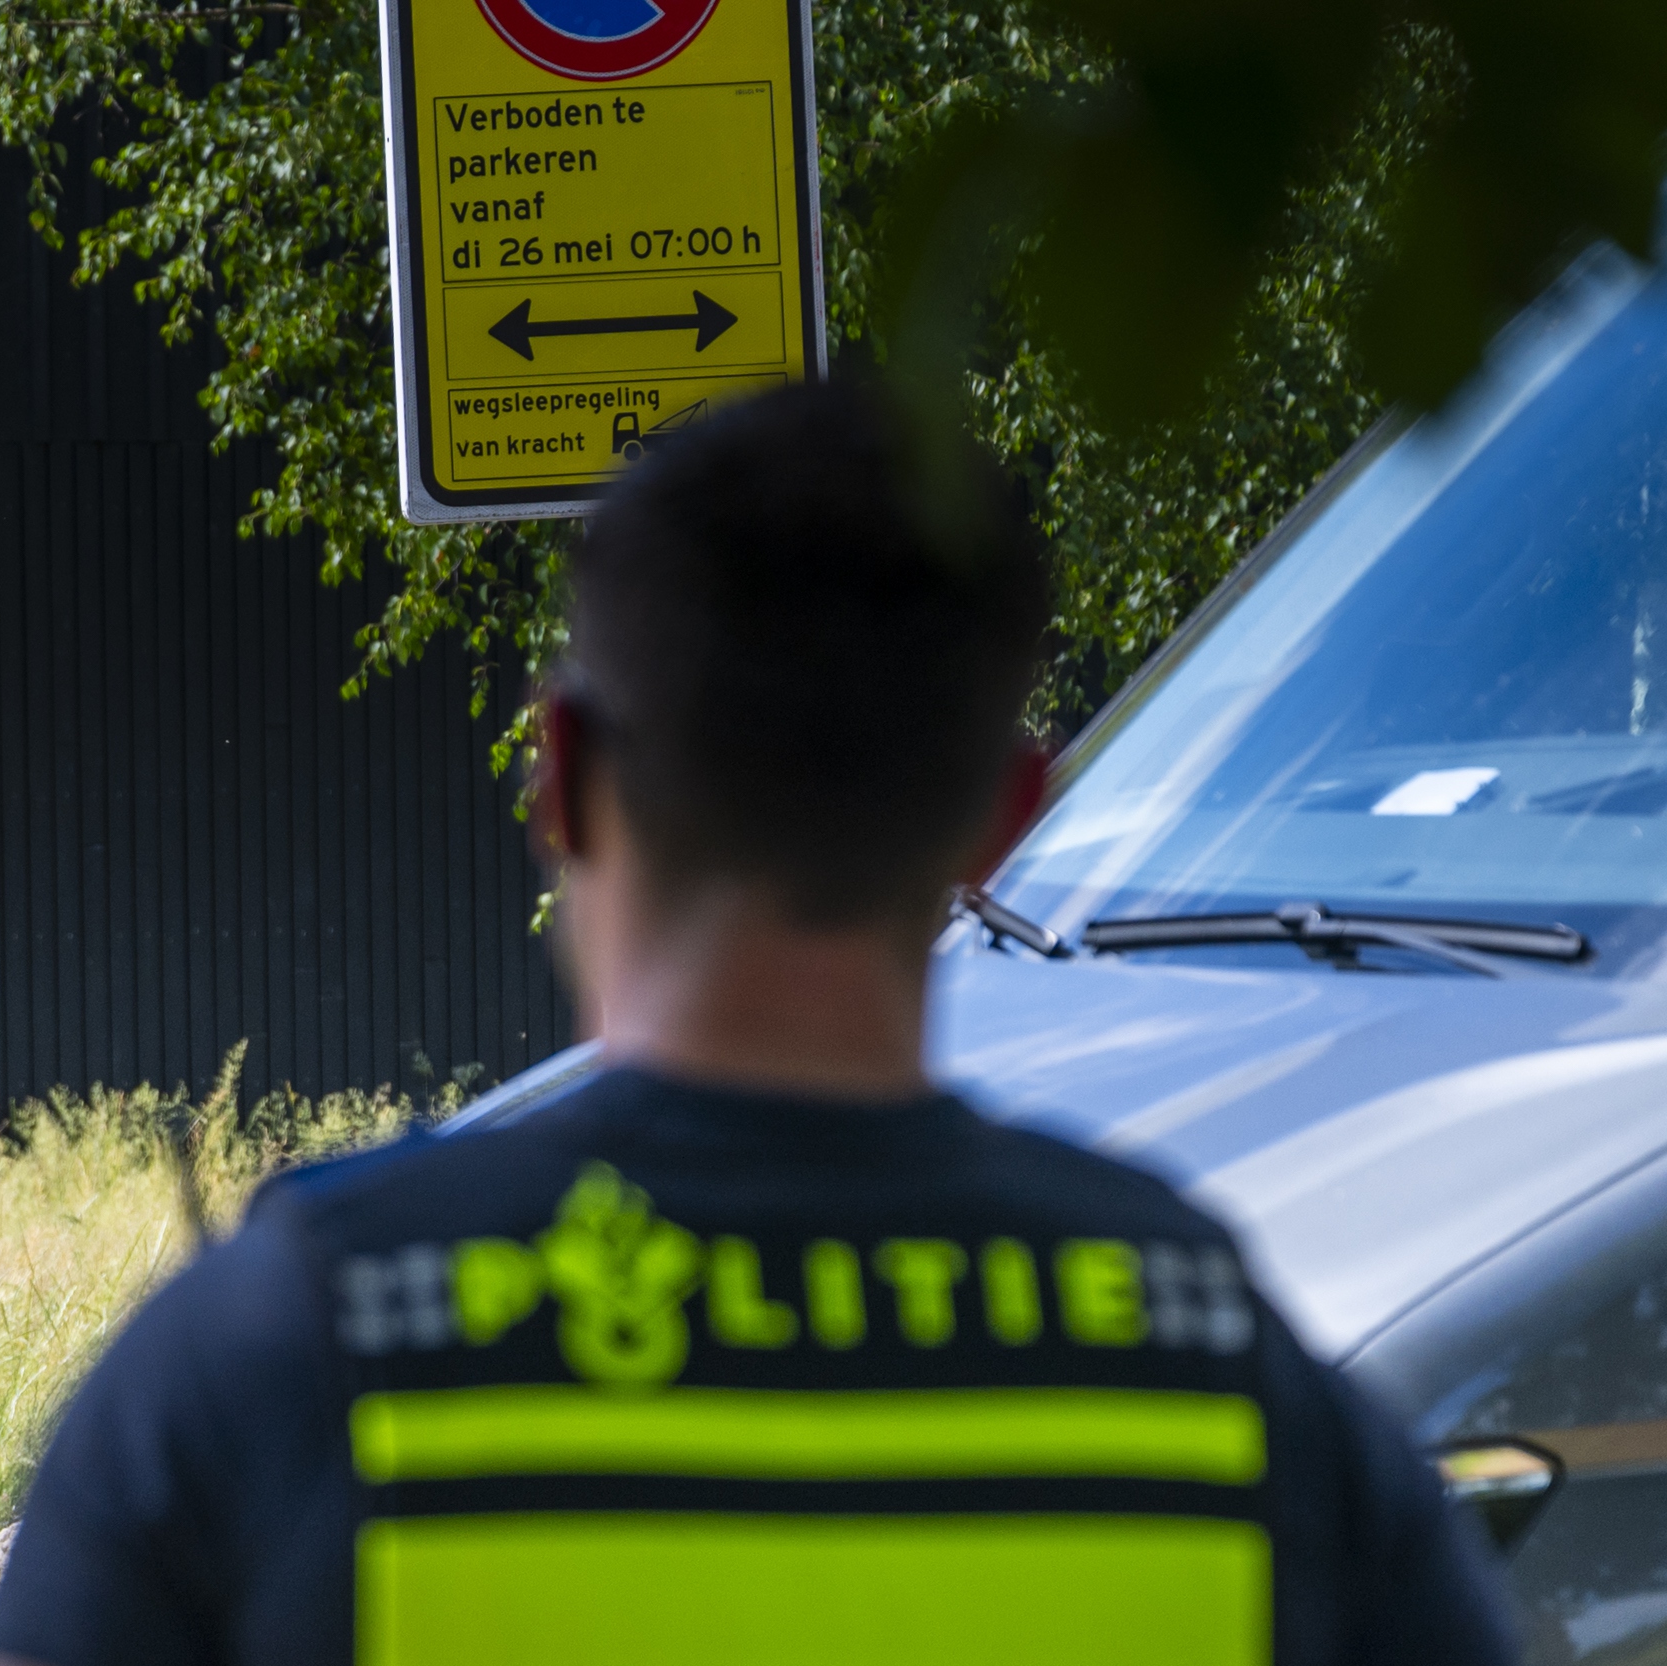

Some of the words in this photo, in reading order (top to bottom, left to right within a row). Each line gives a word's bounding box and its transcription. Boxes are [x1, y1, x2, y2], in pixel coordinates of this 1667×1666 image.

[445, 98, 603, 132] Verboden
[613, 97, 645, 124] te
[449, 147, 597, 184] parkeren
[450, 191, 545, 223] vanaf
[452, 240, 481, 269] di
[499, 237, 543, 266] 26
[554, 233, 612, 263] mei
[630, 226, 733, 259] 07:00
[743, 225, 761, 253] h
[454, 387, 660, 419] wegsleepregeling
[456, 439, 499, 457] van
[507, 432, 585, 455] kracht
